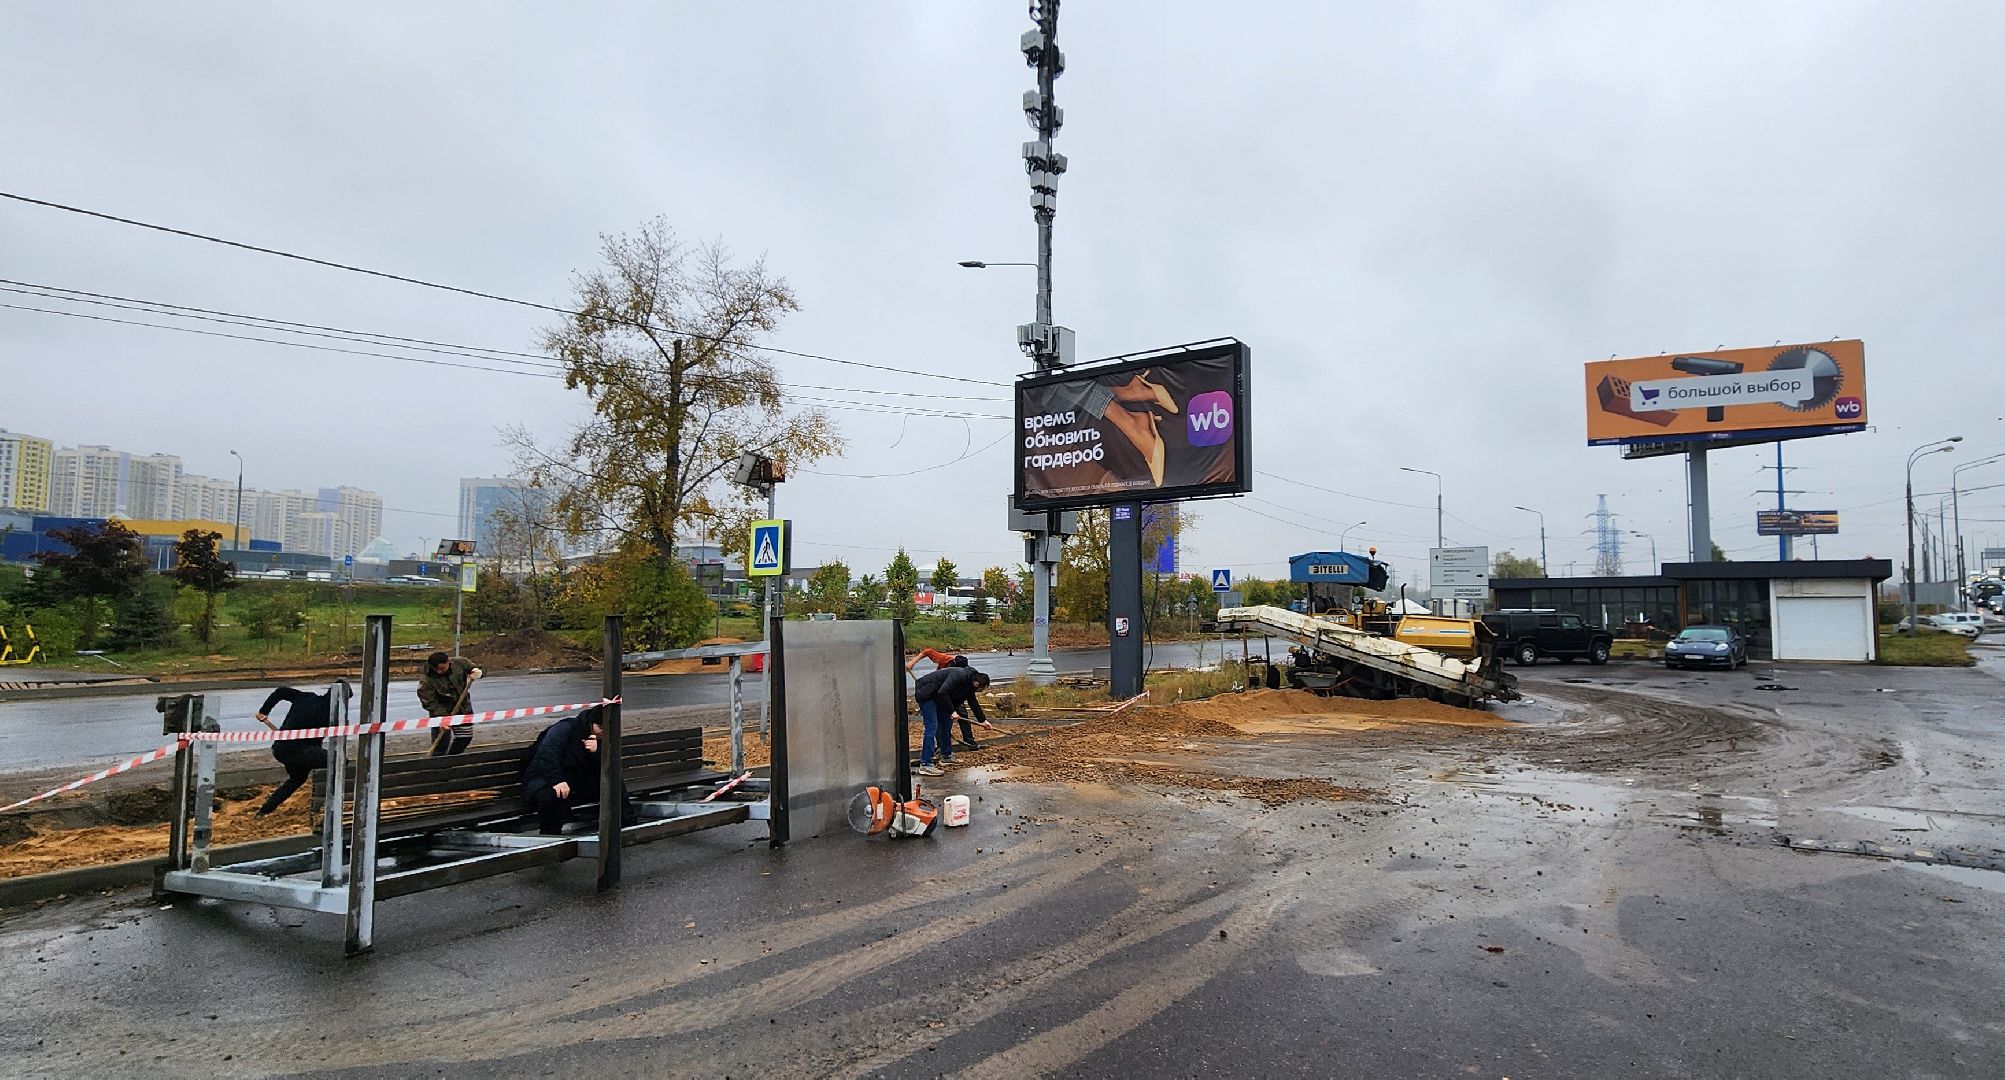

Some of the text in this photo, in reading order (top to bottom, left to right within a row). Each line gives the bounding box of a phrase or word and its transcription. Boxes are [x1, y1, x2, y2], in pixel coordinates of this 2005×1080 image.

[1668, 379, 1801, 398] большой выбор
[1189, 402, 1230, 432] wb
[1836, 401, 1860, 413] wb
[1024, 411, 1076, 433] время
[1024, 428, 1101, 449] обновить
[1024, 442, 1105, 471] гардероб
